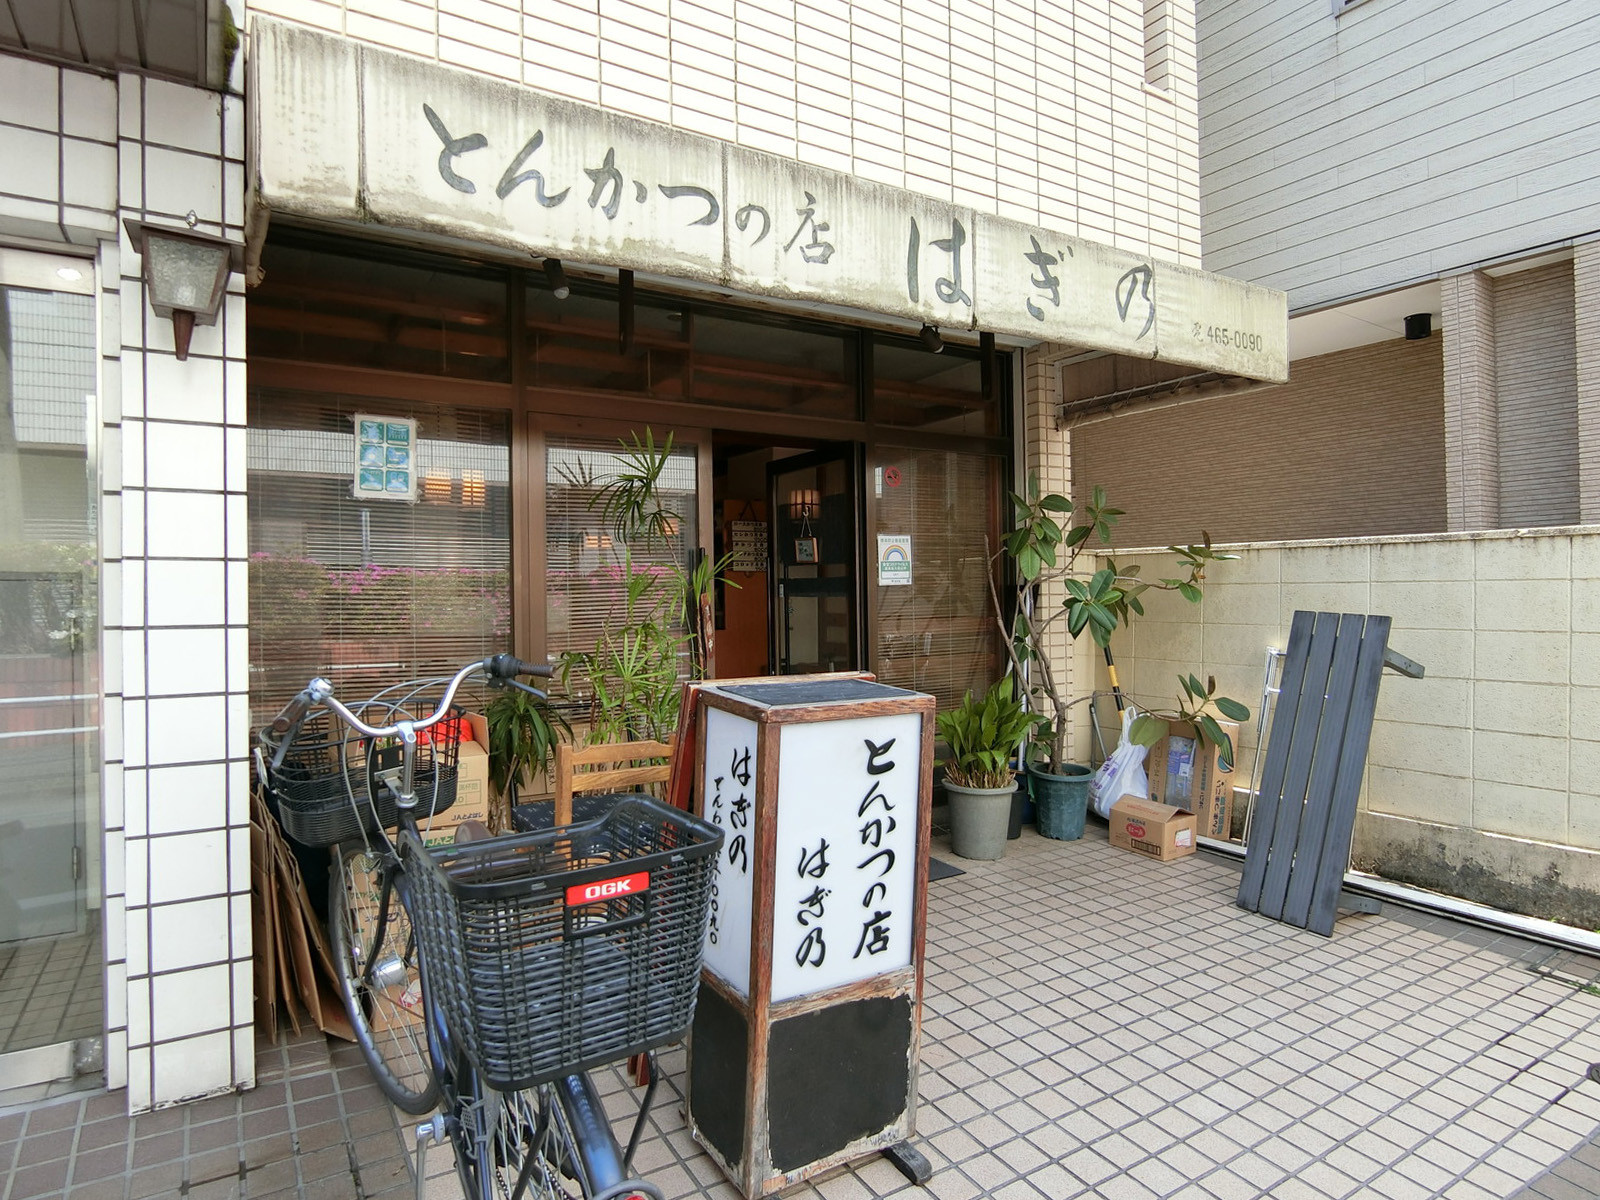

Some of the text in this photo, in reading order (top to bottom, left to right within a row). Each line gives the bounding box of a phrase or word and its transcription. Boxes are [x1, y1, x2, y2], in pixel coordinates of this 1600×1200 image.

[423, 103, 835, 264] とんかつの店
[1207, 326, 1262, 352] 465-0090
[428, 835, 454, 846] JAと
[853, 737, 897, 960] とんかつの店
[585, 879, 631, 899] OGK
